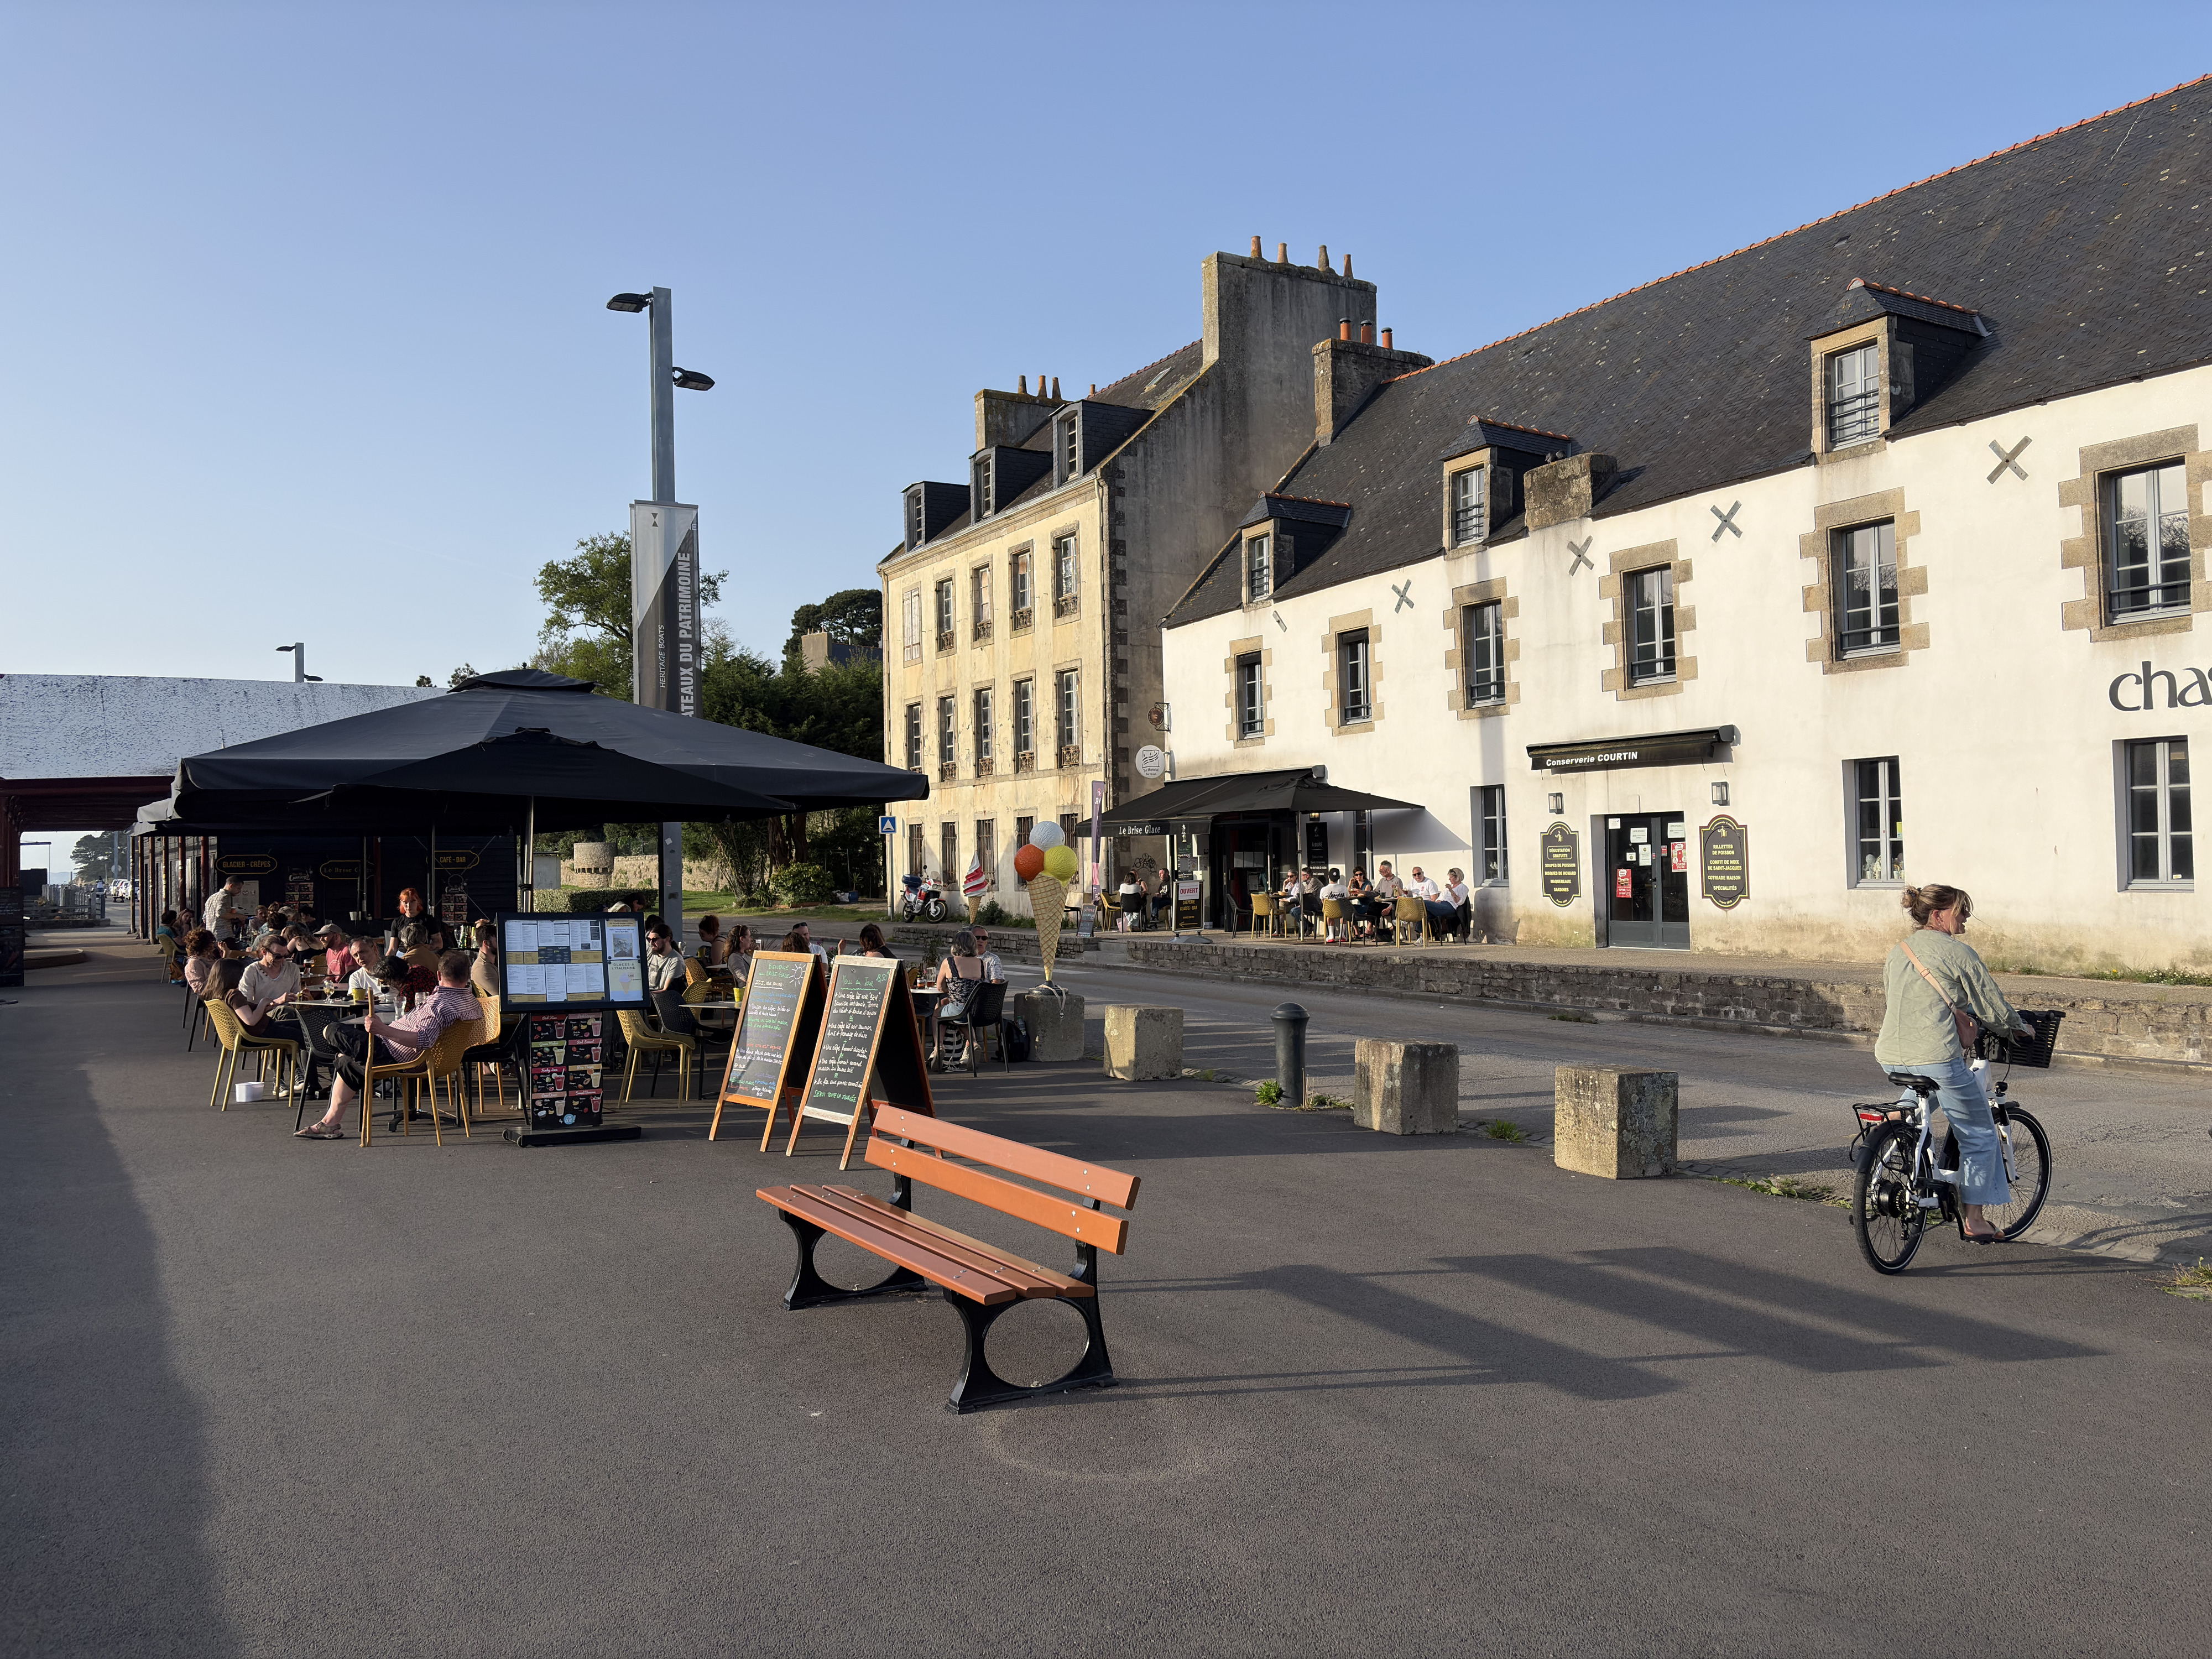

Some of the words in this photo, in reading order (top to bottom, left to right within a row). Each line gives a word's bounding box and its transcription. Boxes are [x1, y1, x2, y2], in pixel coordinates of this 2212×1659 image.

[678, 552, 692, 638] PATRIMOINE
[679, 643, 692, 662] DU
[680, 667, 693, 717] ATEAUX
[1546, 755, 1595, 766] Conserverie
[1598, 752, 1638, 761] COURTIN
[1119, 826, 1126, 834] Le
[1128, 826, 1142, 834] Brise
[1145, 825, 1160, 834] Glace
[843, 975, 852, 985] Menu
[864, 977, 873, 987] Jour
